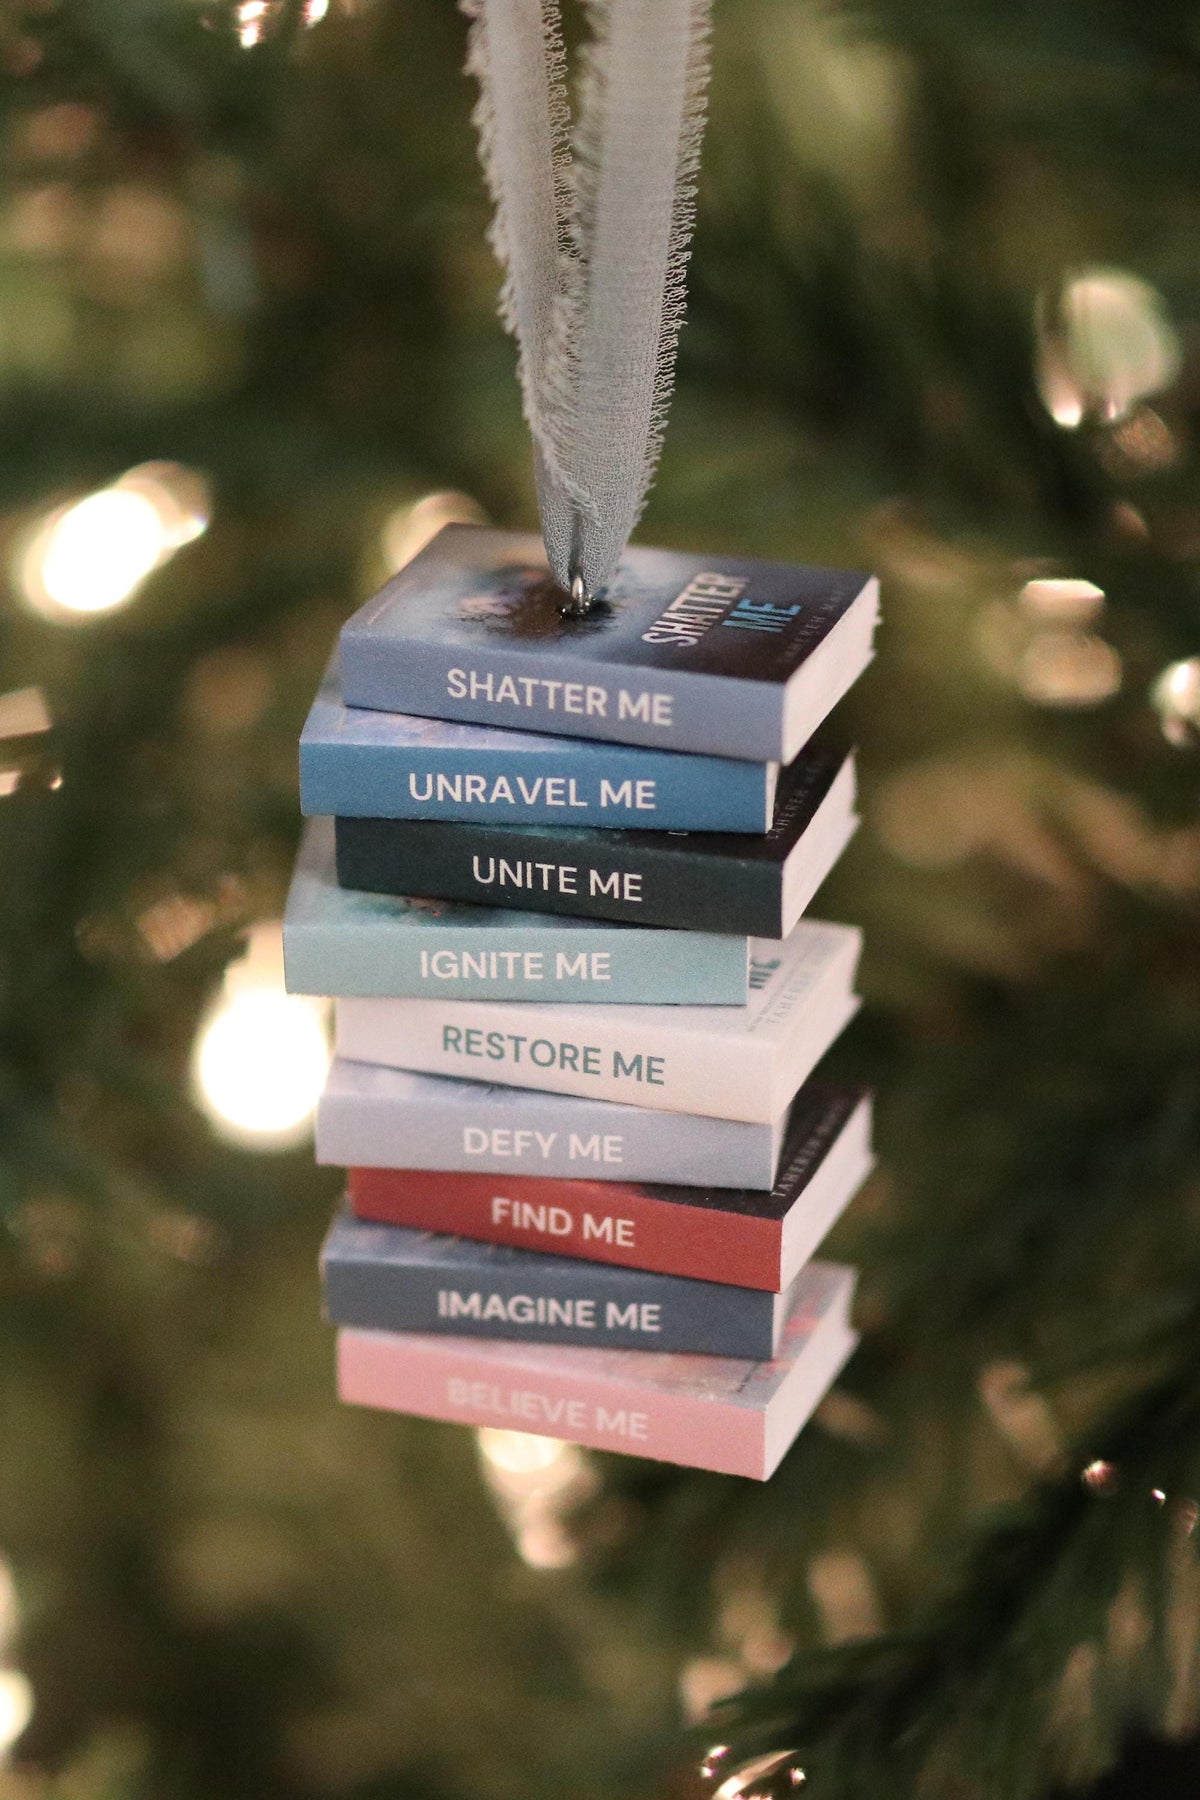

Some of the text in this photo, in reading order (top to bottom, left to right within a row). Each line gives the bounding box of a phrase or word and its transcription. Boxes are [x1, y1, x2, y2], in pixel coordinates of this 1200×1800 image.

[642, 571, 802, 648] SHATTER ME
[446, 667, 674, 726] SHATTER ME
[408, 772, 657, 810] UNRAVEL ME
[472, 854, 644, 903] UNITE ME
[420, 949, 612, 981] IGNITE ME
[442, 1024, 666, 1085] RESTORE ME
[463, 1126, 624, 1164] DEFY ME
[491, 1196, 636, 1248] FIND ME
[437, 1289, 663, 1332] IMAGINE ME
[446, 1377, 649, 1441] BELIEVE ME
